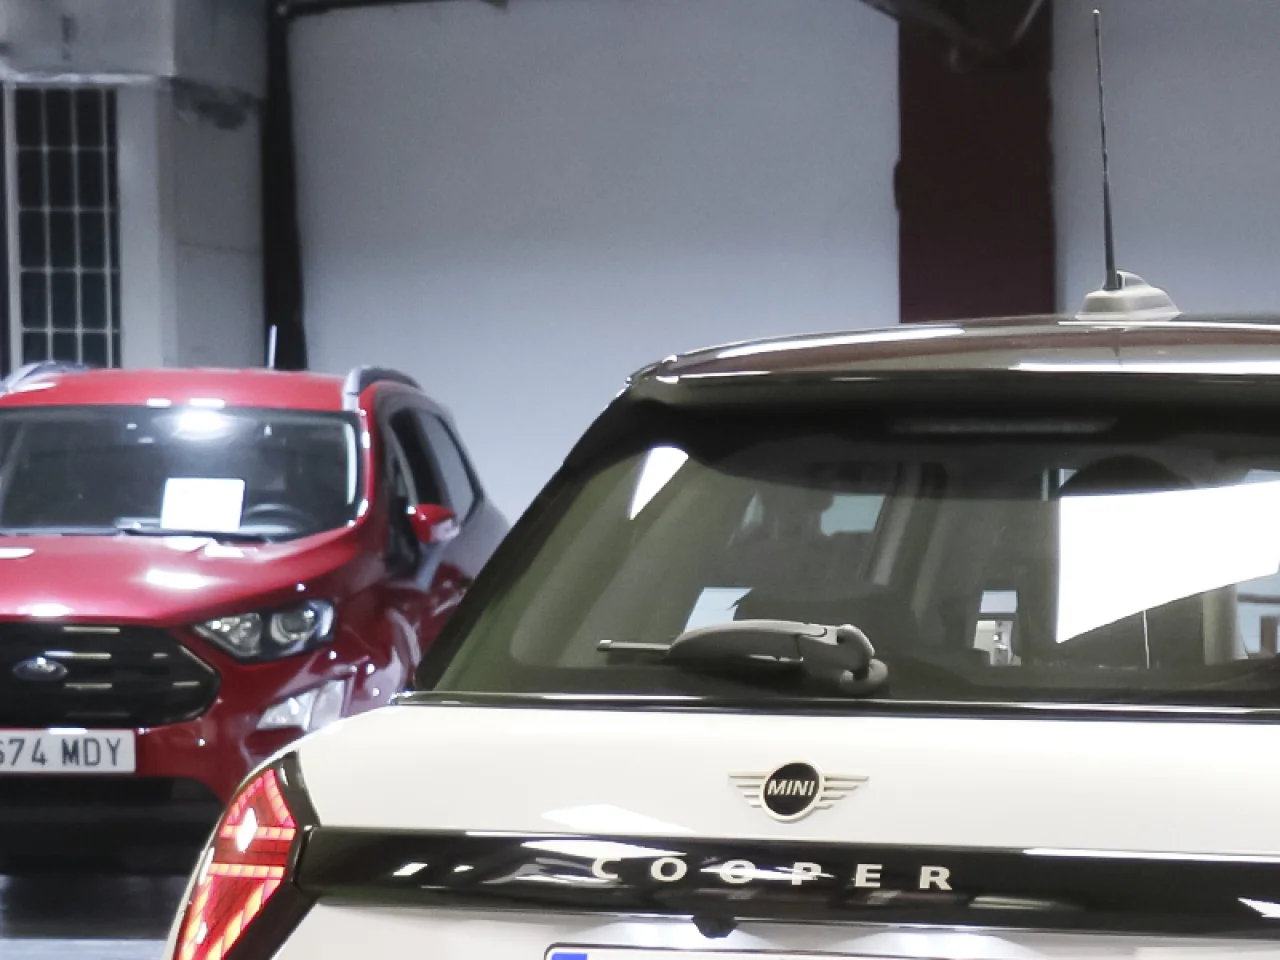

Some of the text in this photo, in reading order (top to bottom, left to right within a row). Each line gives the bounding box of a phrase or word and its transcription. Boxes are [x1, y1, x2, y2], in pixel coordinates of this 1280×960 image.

[61, 737, 121, 766] MDY
[768, 780, 816, 796] MINI
[592, 857, 953, 891] COOPER
